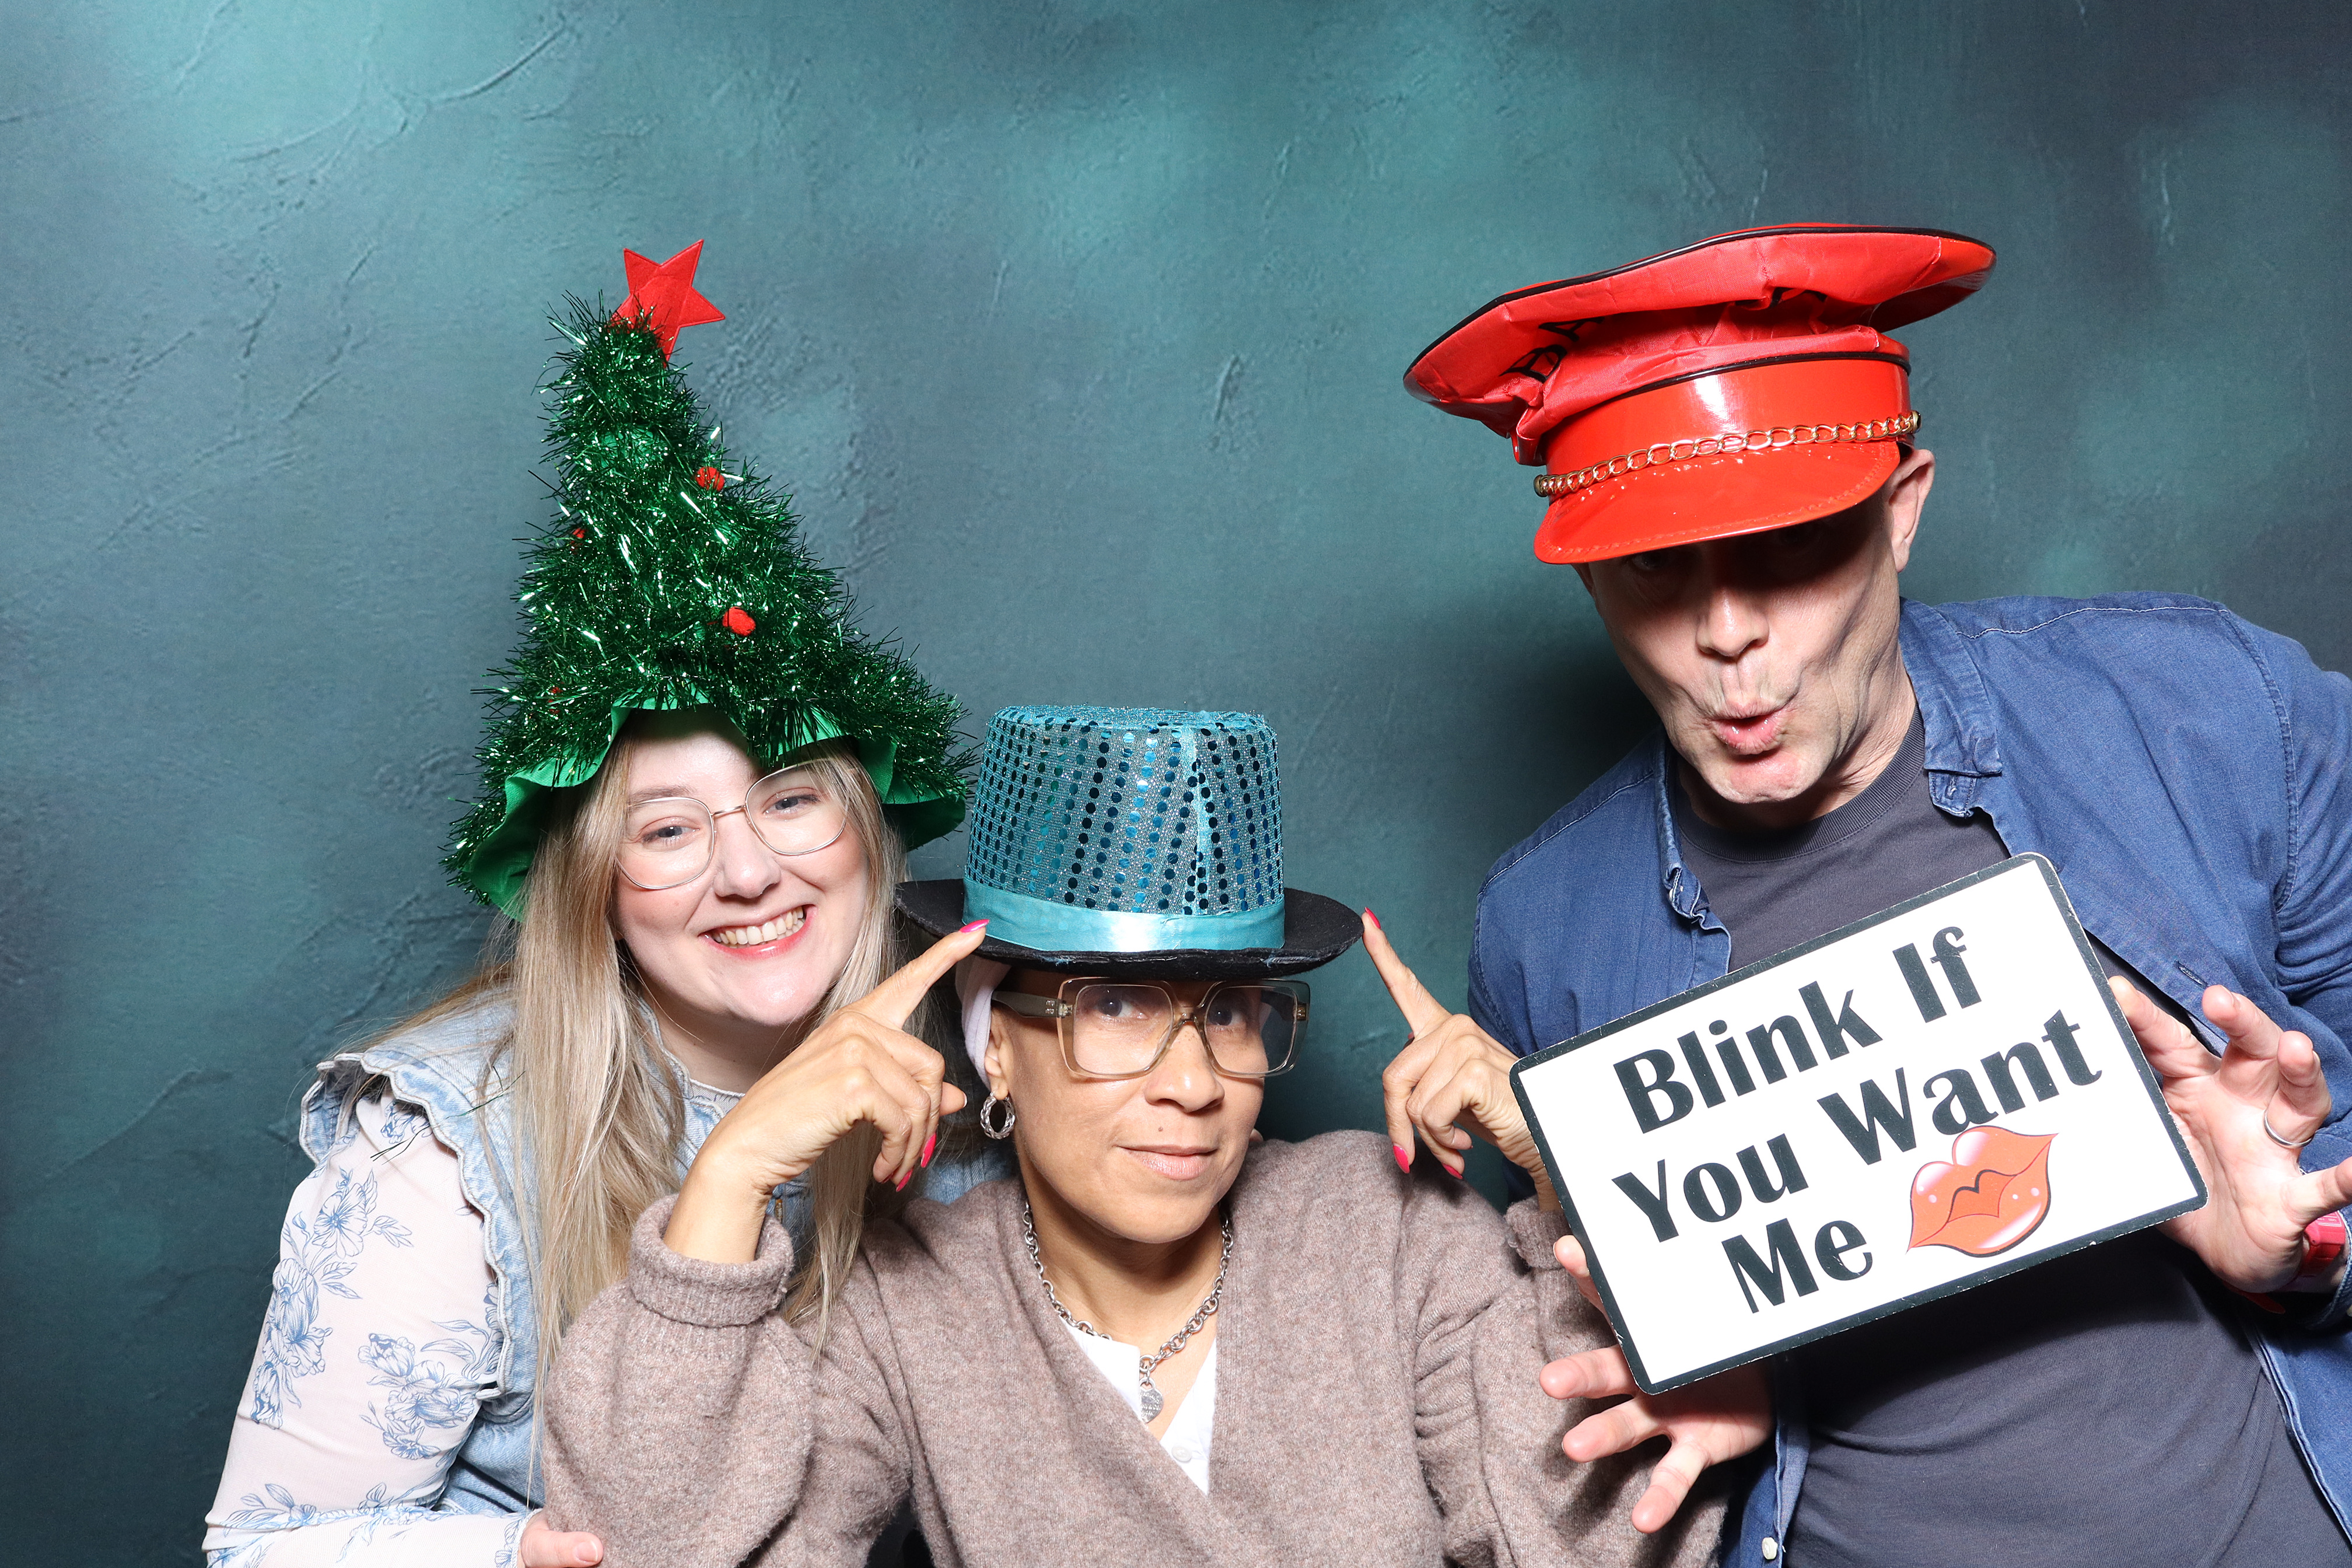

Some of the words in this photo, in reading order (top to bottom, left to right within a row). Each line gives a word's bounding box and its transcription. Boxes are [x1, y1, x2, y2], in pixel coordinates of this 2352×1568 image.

[1612, 1133, 1808, 1242] You
[1817, 1010, 2102, 1165] Want
[1614, 981, 1882, 1133] Blink
[1893, 927, 1982, 1023] If
[1721, 1219, 1873, 1313] Me
